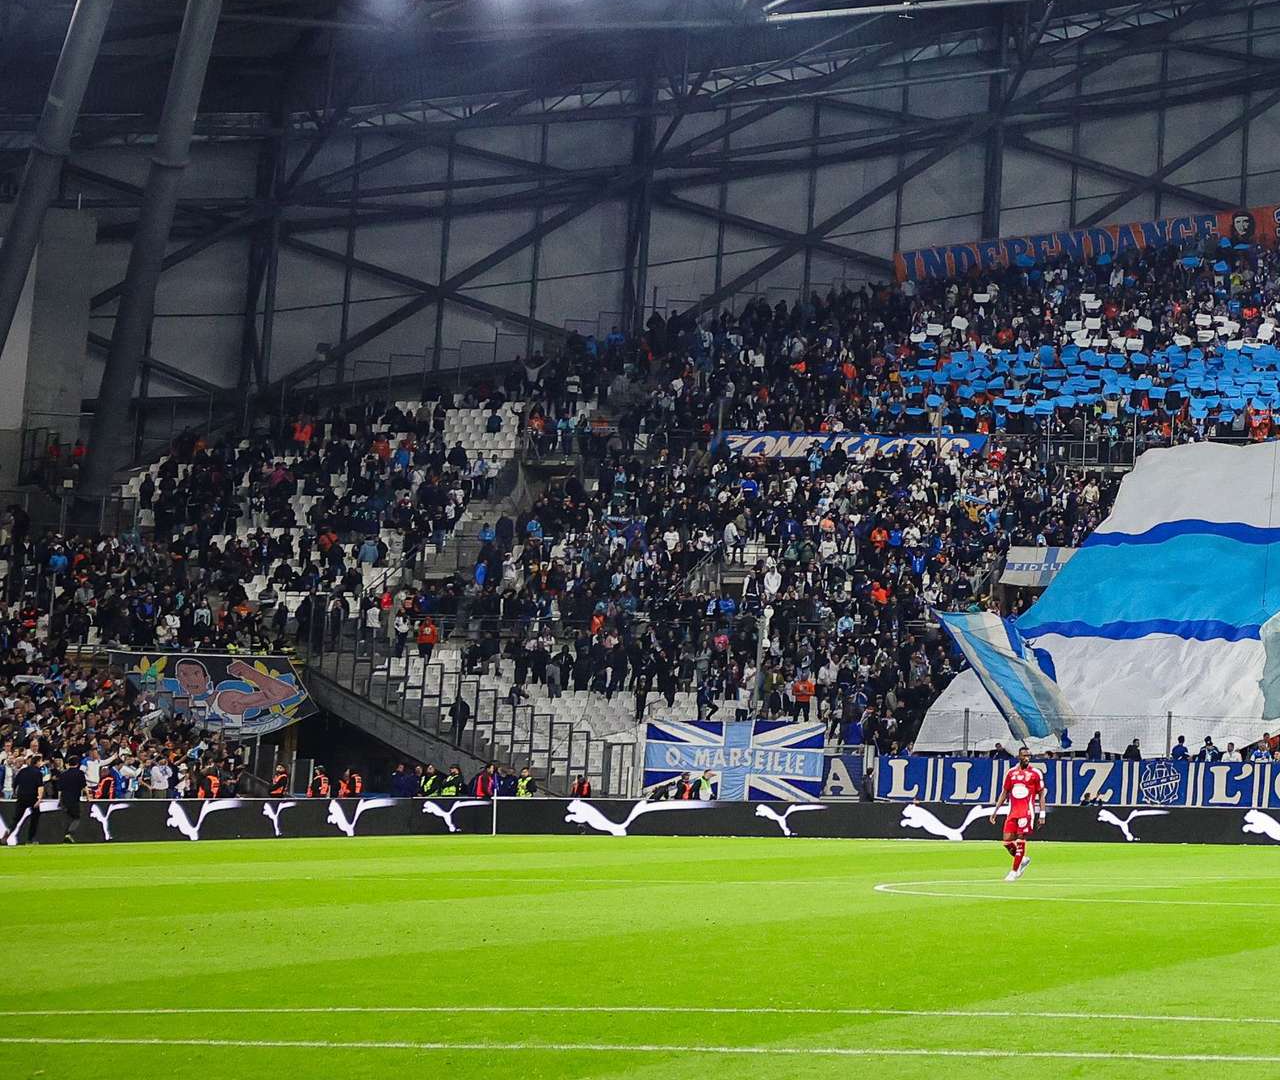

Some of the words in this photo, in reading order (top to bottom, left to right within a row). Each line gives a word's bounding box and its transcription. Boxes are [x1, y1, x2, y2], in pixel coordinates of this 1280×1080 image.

[727, 434, 829, 458] ZONE
[665, 747, 687, 768] O.
[693, 748, 807, 775] MARSEILLE
[820, 758, 1114, 803] ALLZ
